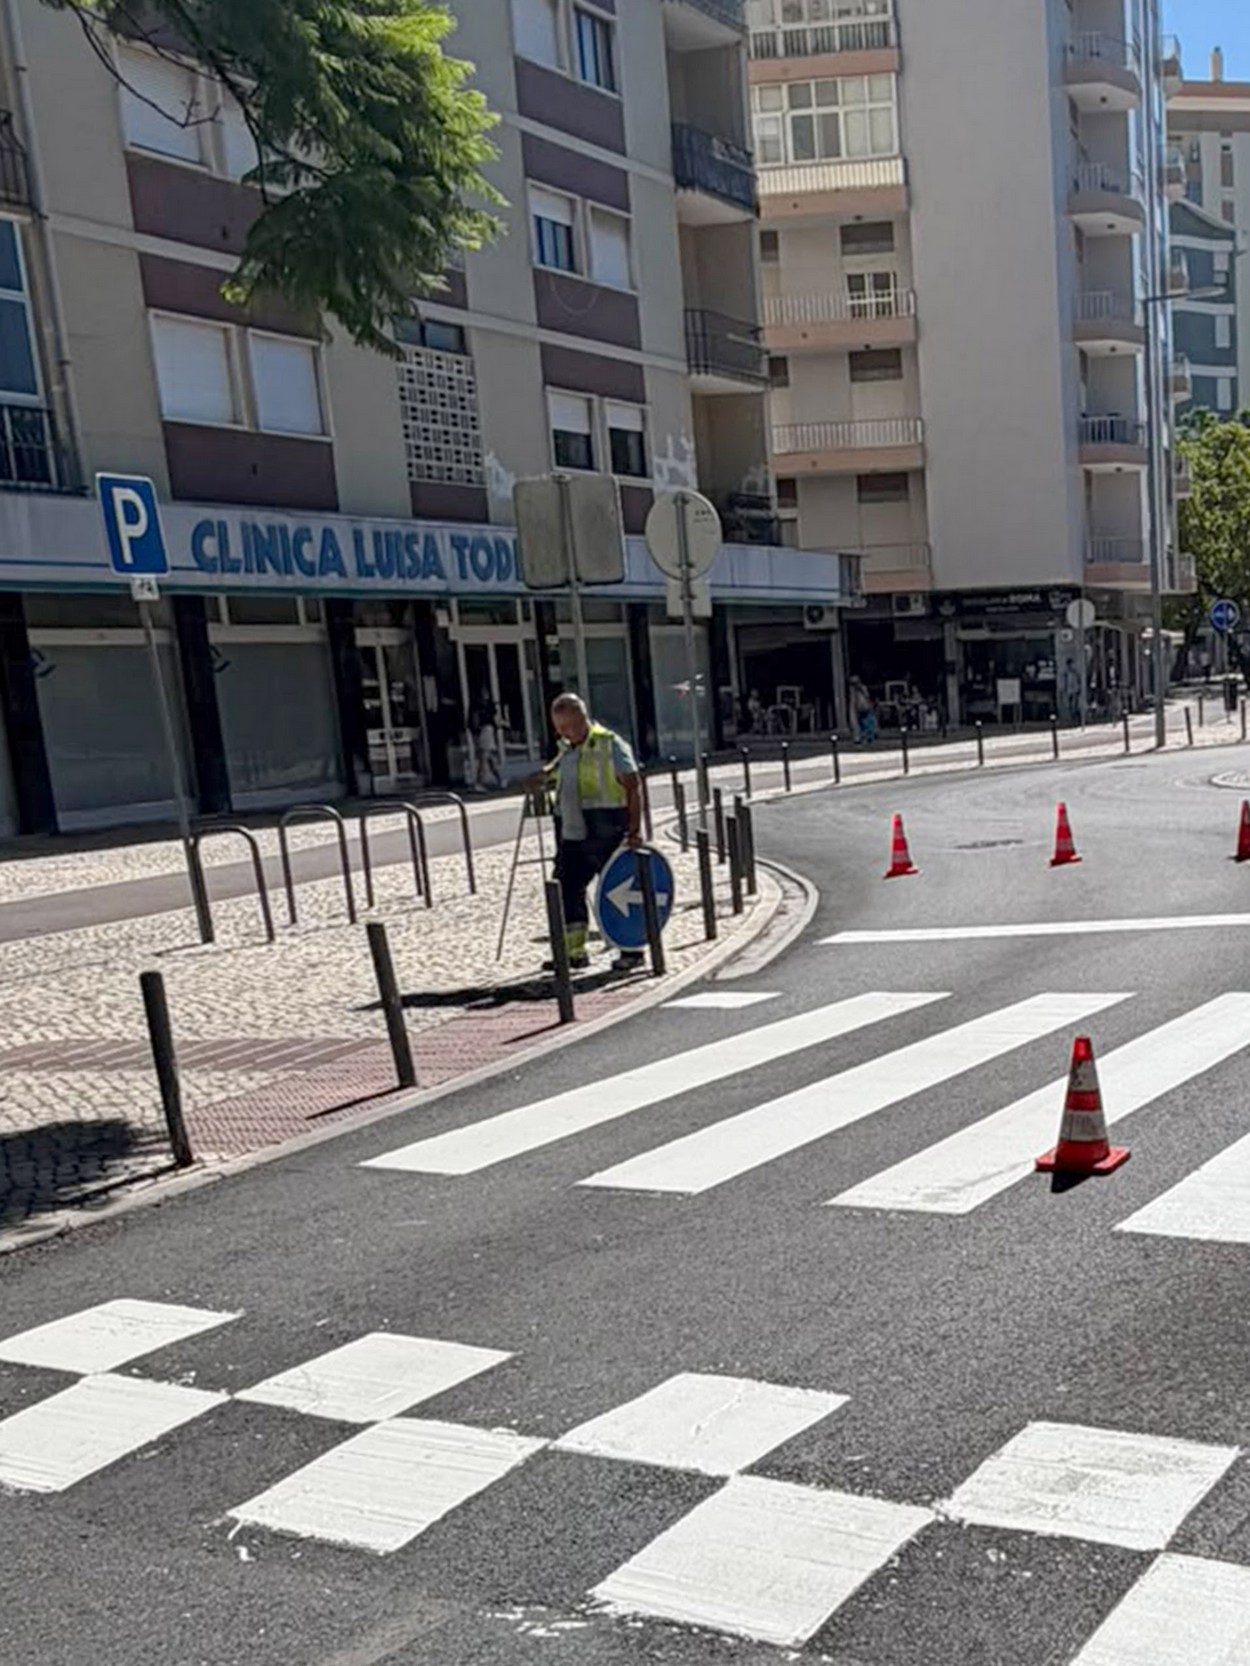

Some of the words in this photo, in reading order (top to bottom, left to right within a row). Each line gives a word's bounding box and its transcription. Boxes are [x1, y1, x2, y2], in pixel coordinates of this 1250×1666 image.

[111, 486, 148, 564] P
[191, 519, 348, 578] CLINICA
[352, 527, 447, 580] LUISA
